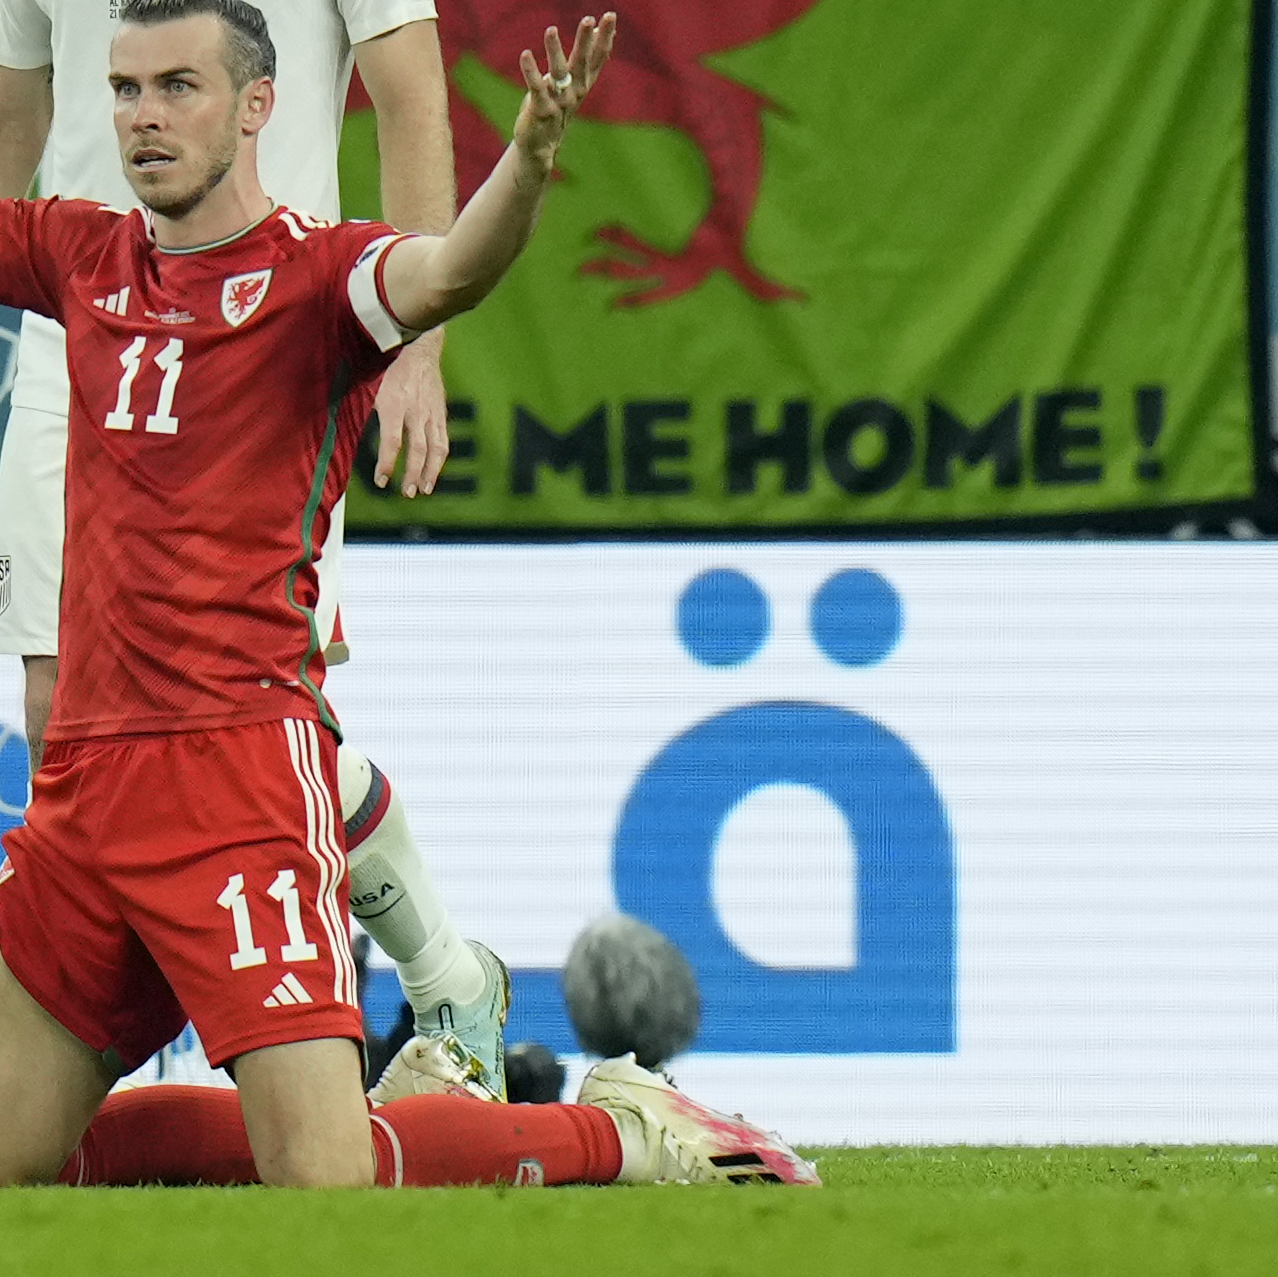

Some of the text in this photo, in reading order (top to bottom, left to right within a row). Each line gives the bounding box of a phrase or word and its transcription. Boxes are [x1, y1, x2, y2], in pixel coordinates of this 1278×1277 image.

[104, 335, 185, 435] 11
[512, 398, 692, 496] ME
[216, 868, 319, 971] 11
[349, 881, 394, 907] USA
